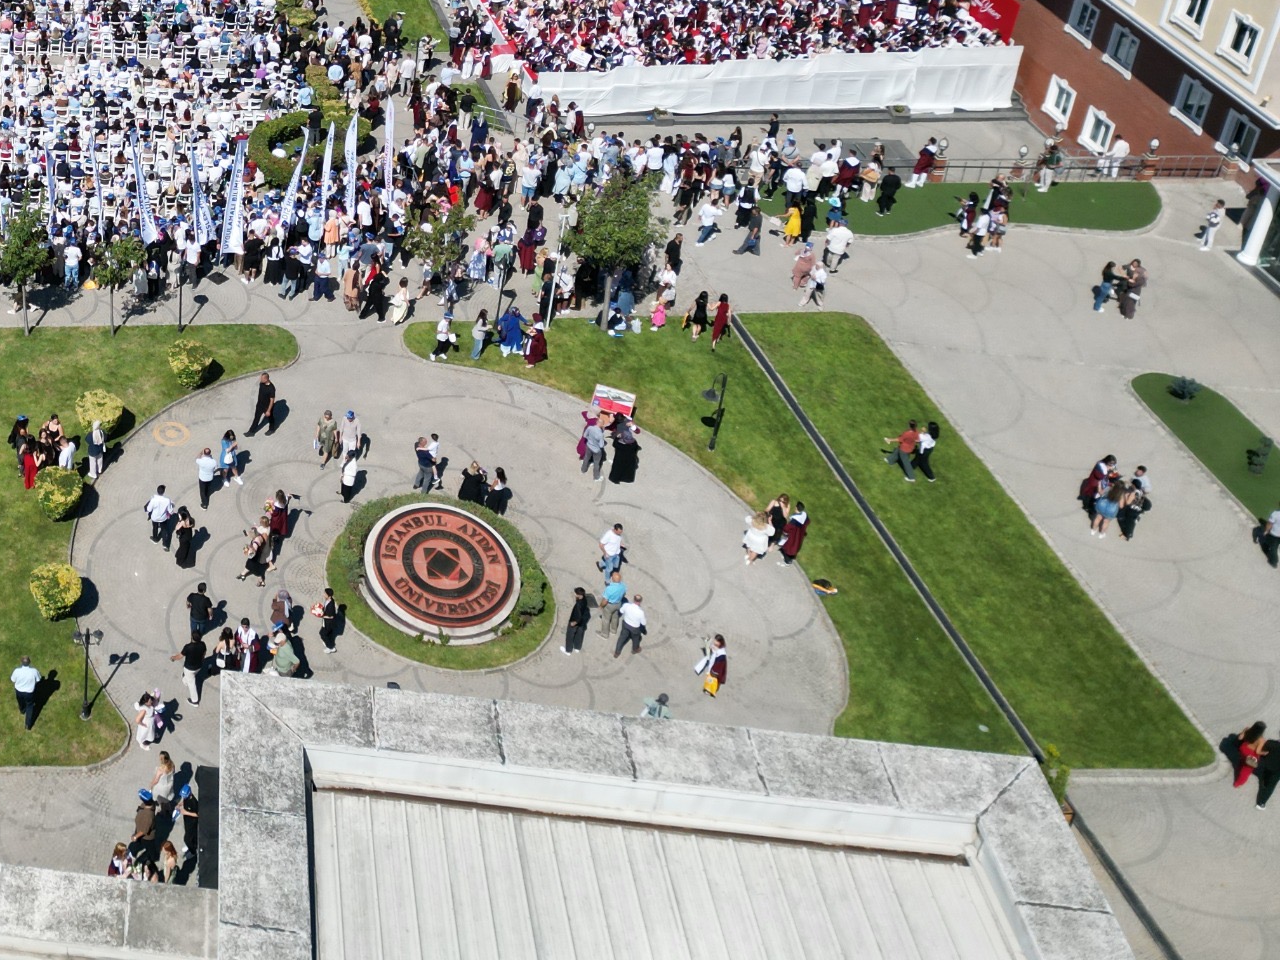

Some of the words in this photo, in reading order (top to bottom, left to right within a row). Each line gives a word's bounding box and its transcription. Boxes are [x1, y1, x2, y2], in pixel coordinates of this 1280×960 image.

[382, 514, 448, 560] İSTANBUL
[456, 523, 501, 565] AYDIN
[394, 576, 501, 615] ÜNİVERSİTESİ
